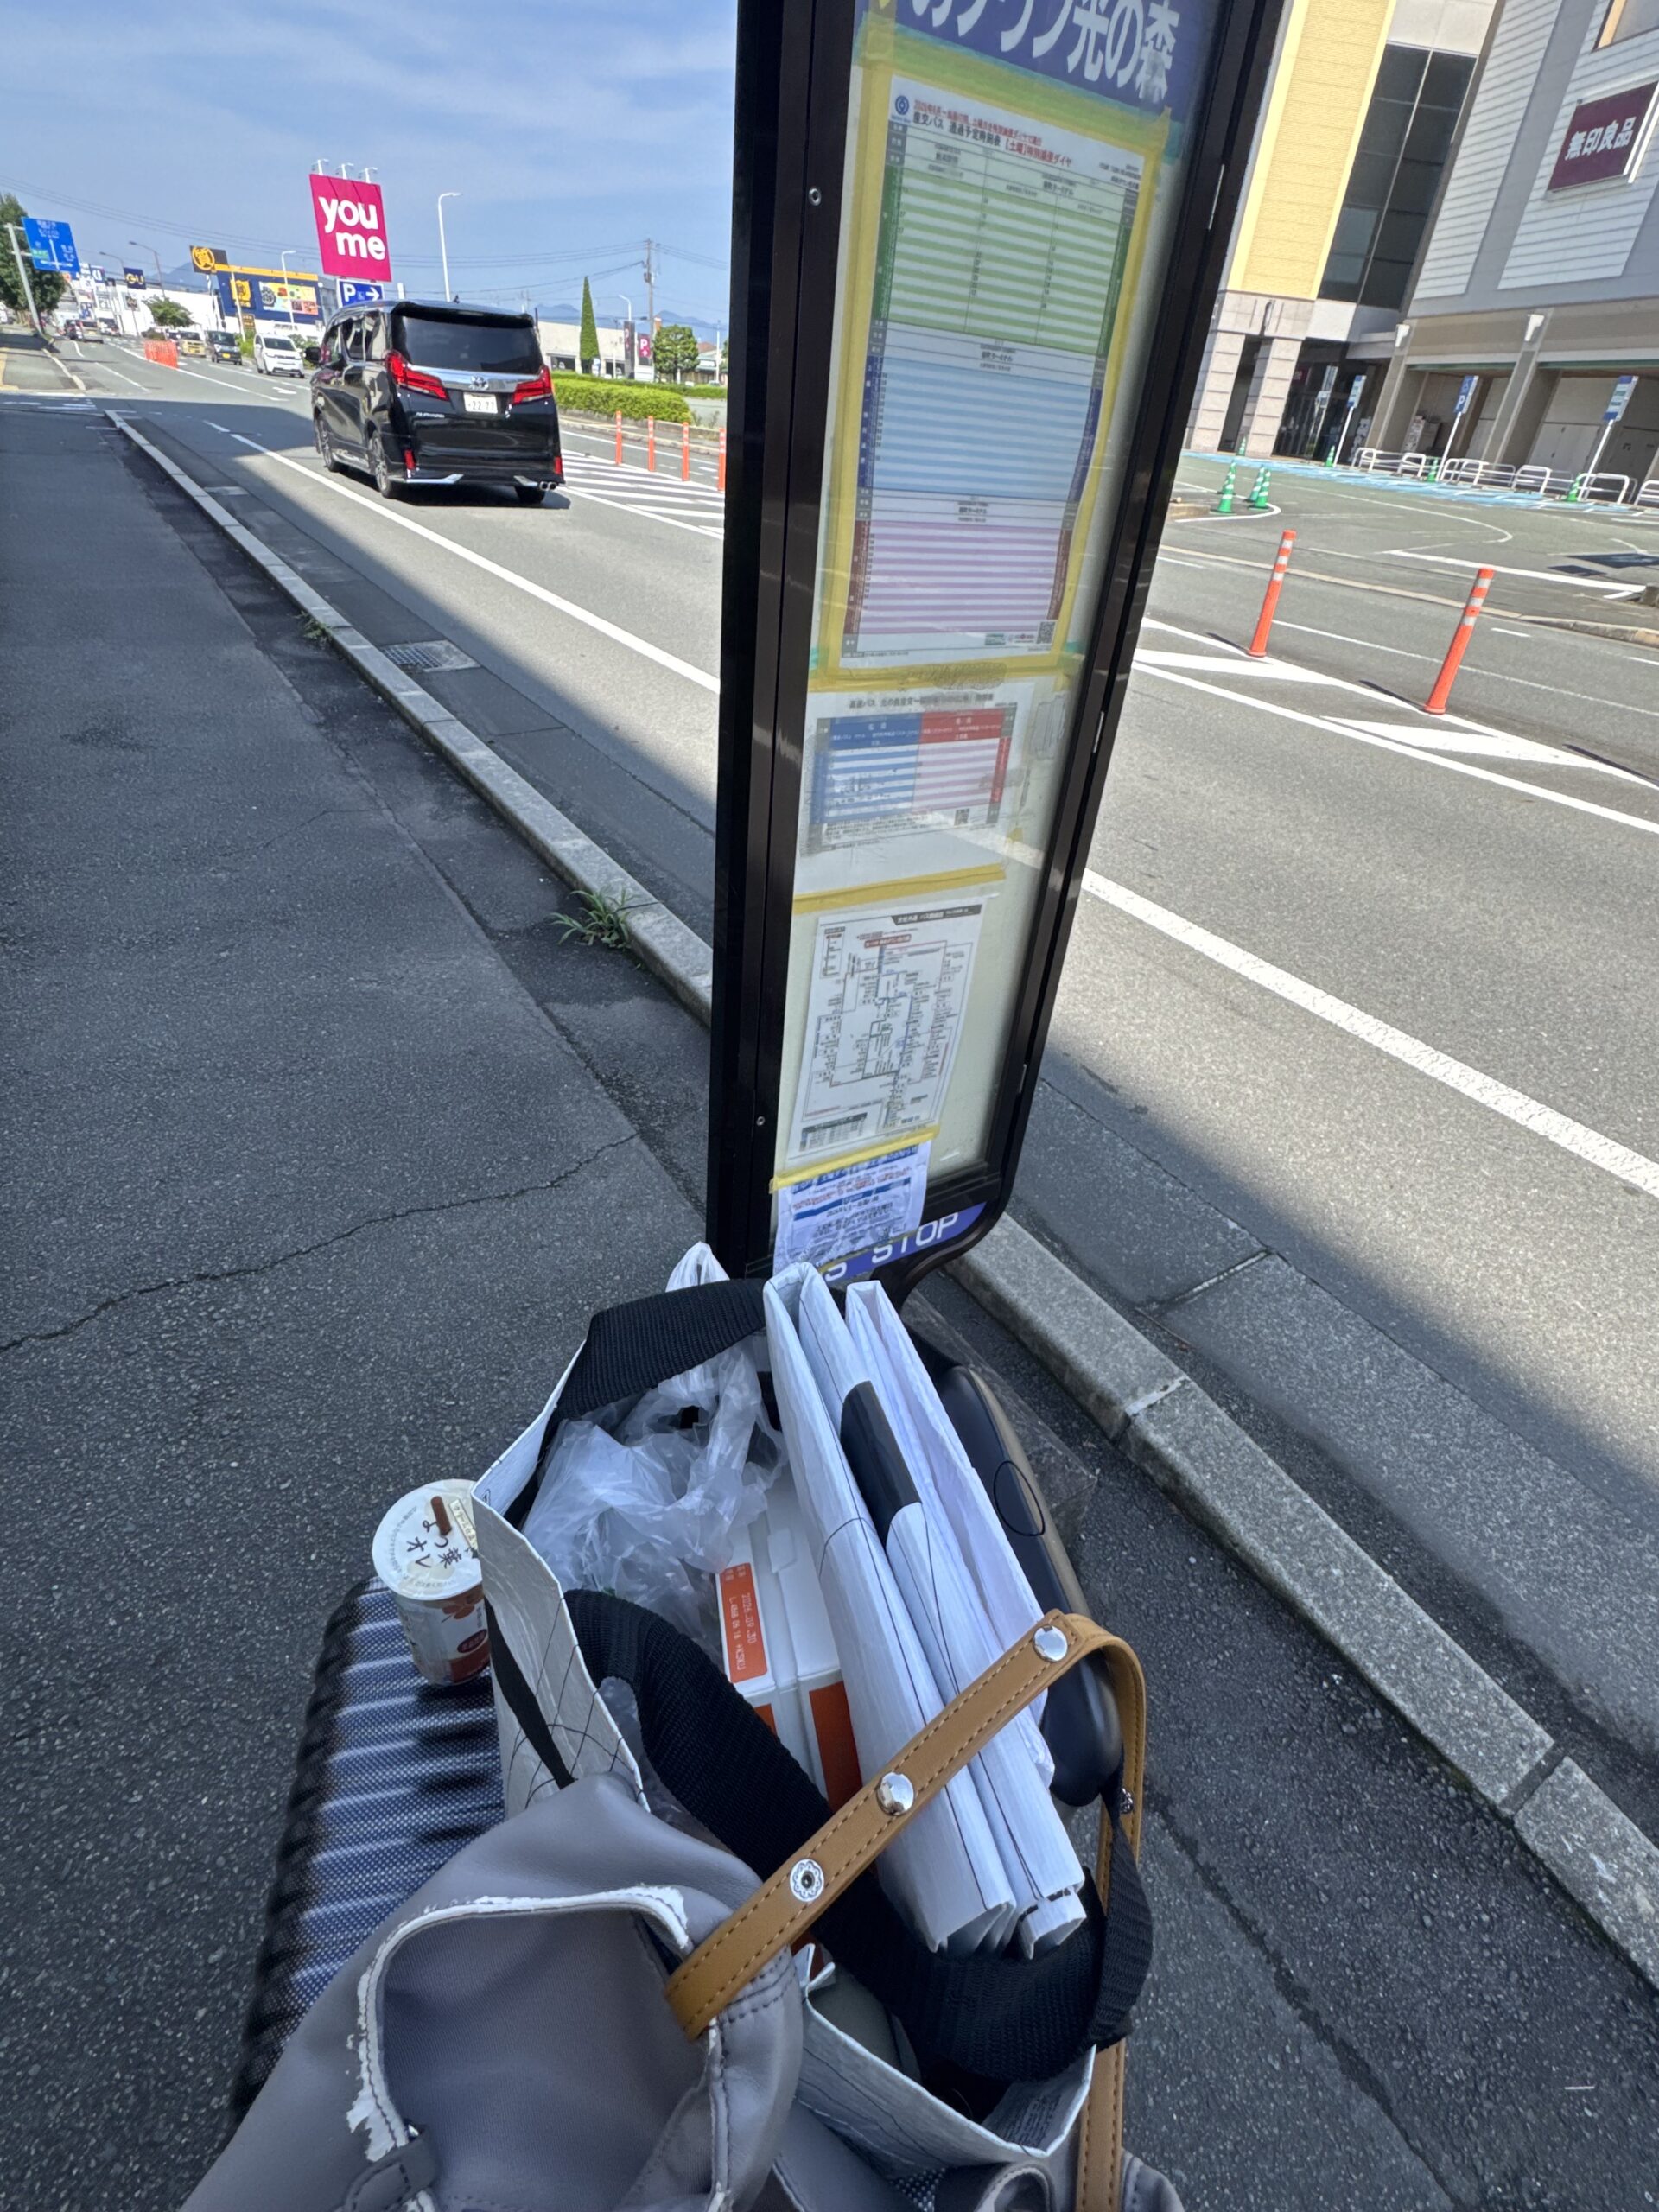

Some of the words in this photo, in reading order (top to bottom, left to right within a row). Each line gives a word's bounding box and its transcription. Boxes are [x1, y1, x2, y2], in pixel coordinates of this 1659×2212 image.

[1564, 116, 1637, 161] 無印良品
[318, 196, 378, 233] you
[335, 232, 385, 260] me
[125, 273, 143, 284] GU
[342, 283, 356, 302] P
[640, 338, 648, 350] P
[1456, 395, 1465, 410] P
[406, 1536, 432, 1569] オレ
